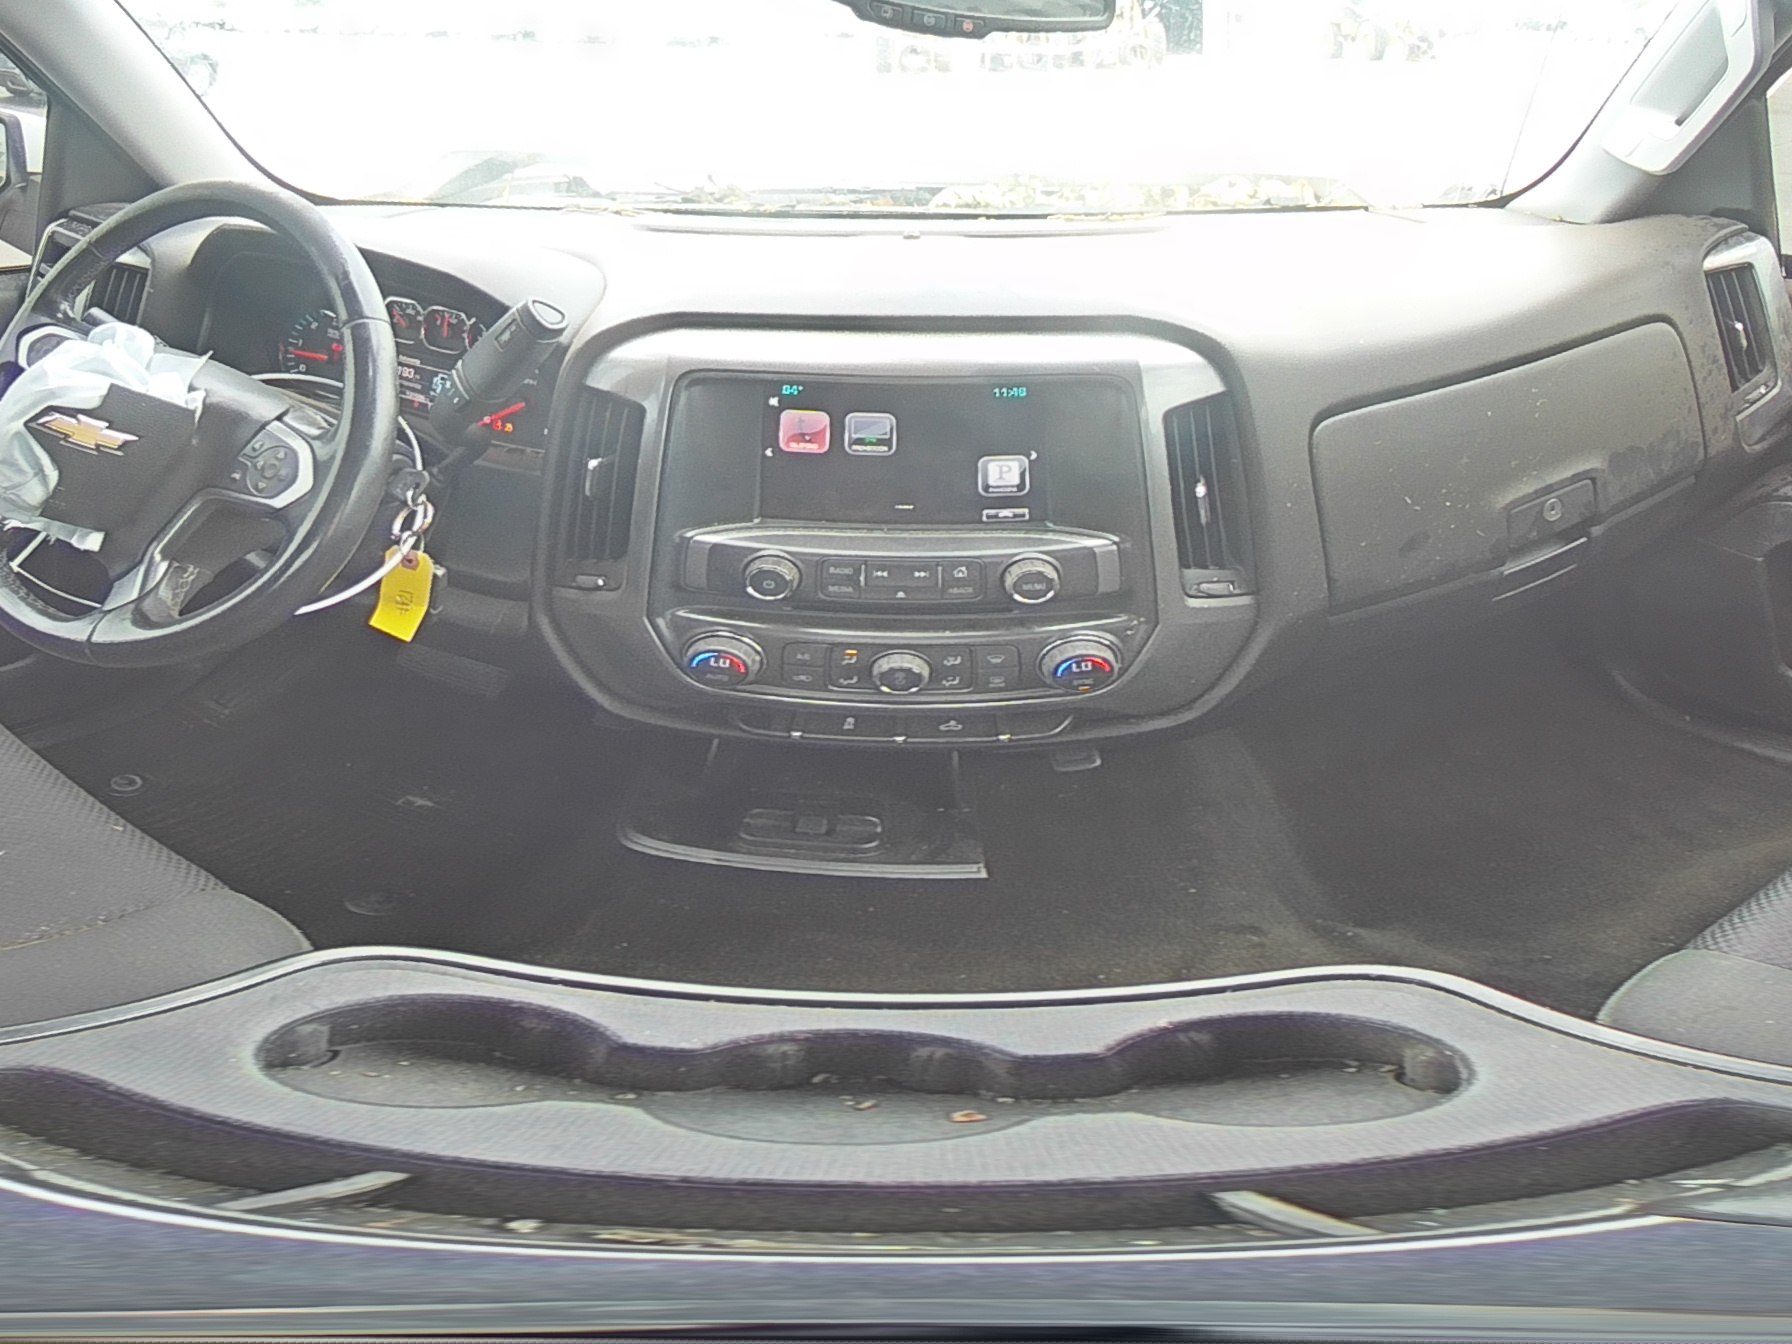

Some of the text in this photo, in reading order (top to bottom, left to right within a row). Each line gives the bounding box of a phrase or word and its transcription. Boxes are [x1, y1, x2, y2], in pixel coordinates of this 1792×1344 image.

[829, 566, 853, 575] RADIO
[828, 585, 853, 593] MEDIA
[1022, 582, 1046, 591] MENU
[708, 657, 731, 668] LO
[1071, 661, 1094, 673] LO
